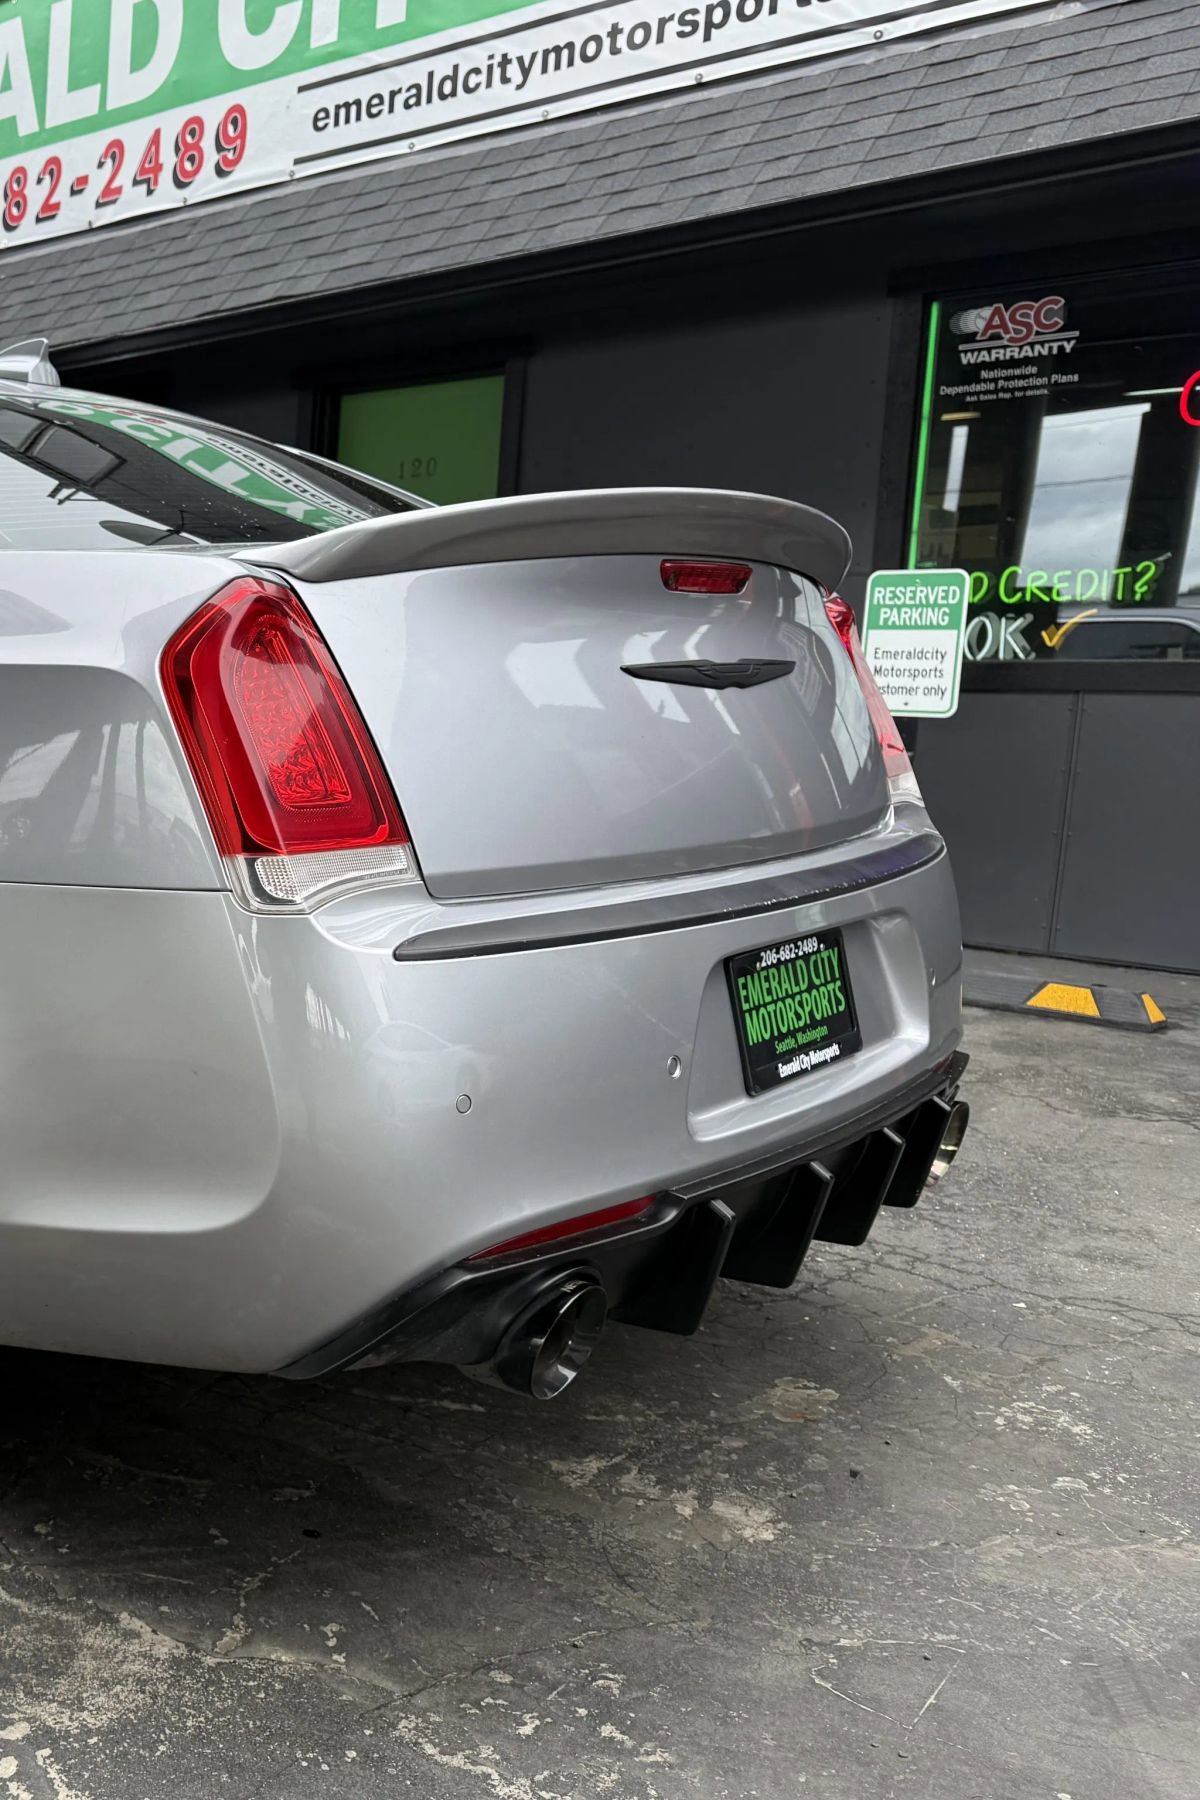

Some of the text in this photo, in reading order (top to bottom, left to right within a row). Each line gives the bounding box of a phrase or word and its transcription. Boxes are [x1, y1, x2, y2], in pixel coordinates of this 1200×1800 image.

[311, 0, 833, 132] emeraldcitymotorspo
[976, 296, 1065, 345] ASC
[960, 340, 1077, 365] WARRANTY
[940, 372, 1079, 396] Dependable Protection Plans
[980, 365, 1038, 380] Nationwide
[399, 457, 438, 480] 120
[998, 560, 1157, 605] CREDIT?
[872, 585, 960, 606] RESERVED
[879, 606, 950, 626] PARKING
[964, 612, 1036, 661] OK
[873, 647, 947, 664] Emeraldcity
[873, 664, 944, 681] Motorsports
[879, 683, 947, 700] stomer only
[760, 935, 818, 968] 206-682-2489
[737, 946, 841, 1011] EMERALD CITY
[744, 980, 846, 1046] MOTORSPORTS
[796, 1024, 829, 1046] Washington
